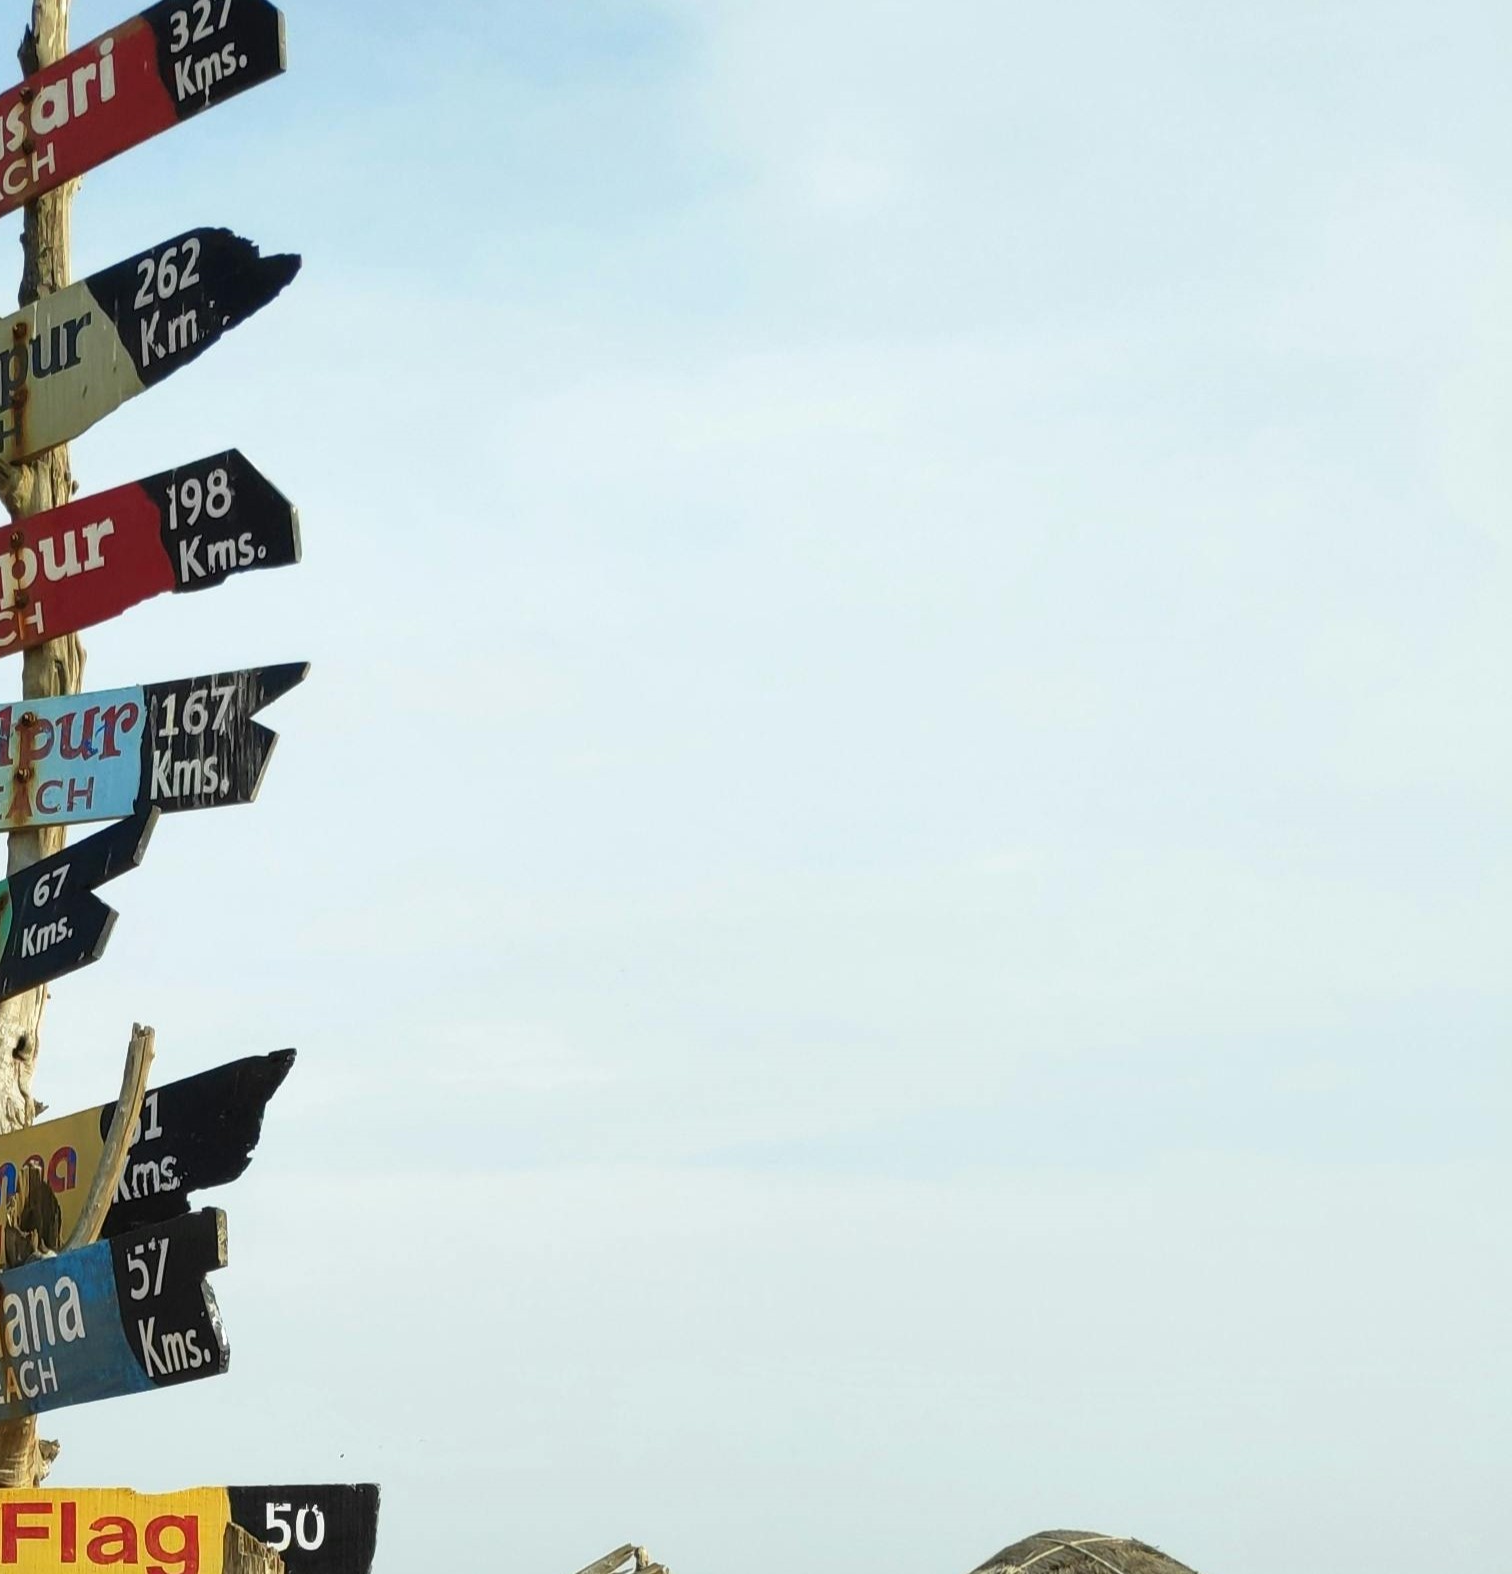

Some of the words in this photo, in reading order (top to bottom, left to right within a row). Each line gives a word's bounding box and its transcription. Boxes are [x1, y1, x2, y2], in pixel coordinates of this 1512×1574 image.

[170, 0, 231, 53] 327
[174, 42, 248, 102] Kms.
[134, 237, 201, 310] 262
[167, 469, 232, 530] 198
[179, 533, 266, 583] Kms.
[159, 685, 236, 737] 167
[150, 750, 229, 800] Kms.
[33, 864, 71, 907] 67
[22, 913, 73, 958] Kms.
[129, 1092, 163, 1148] 1
[127, 1237, 169, 1301] 57
[138, 1316, 211, 1378] Kms.
[1, 1501, 199, 1574] Flag
[265, 1502, 325, 1552] 50
